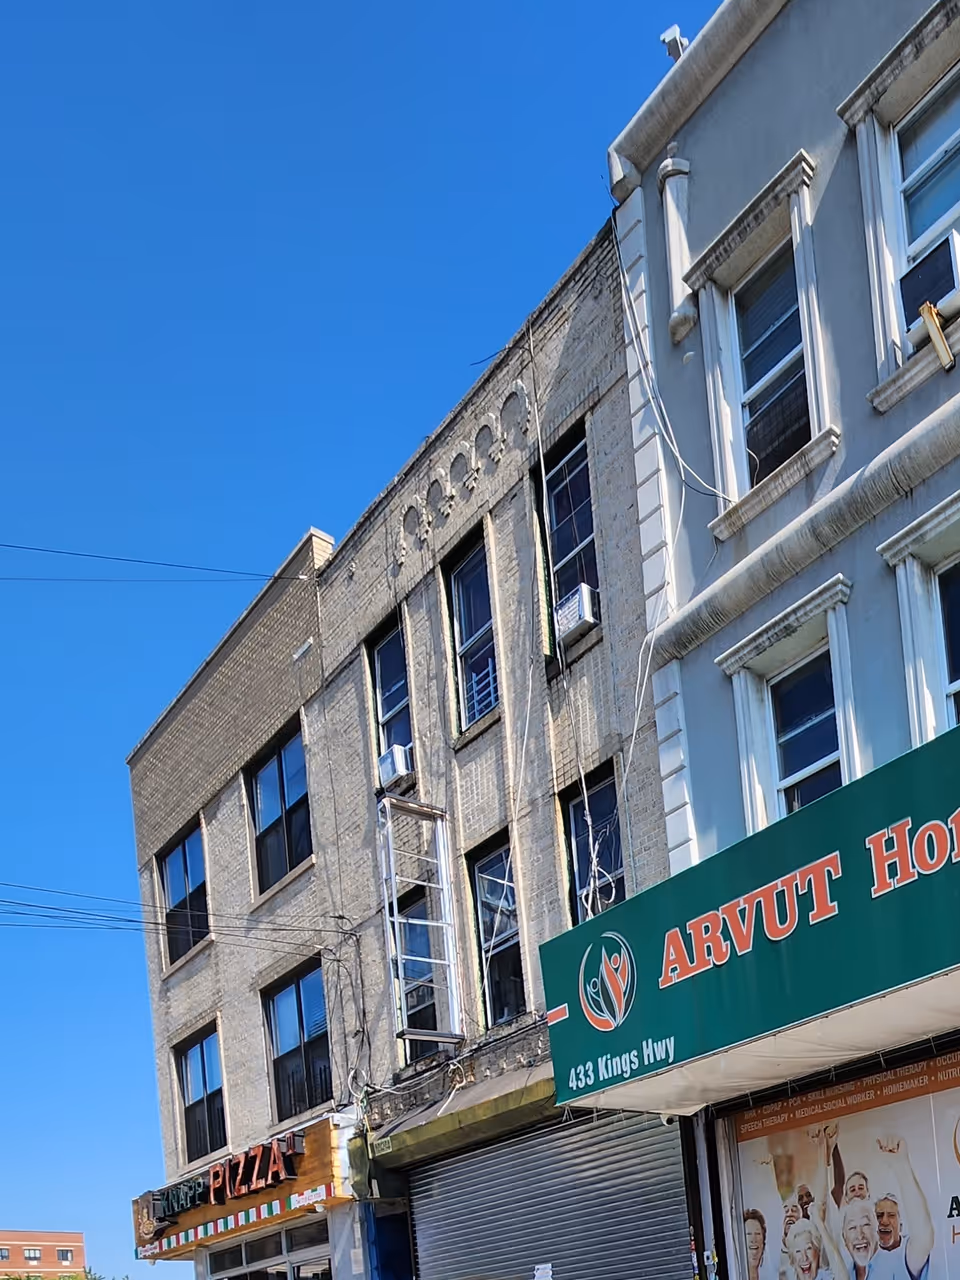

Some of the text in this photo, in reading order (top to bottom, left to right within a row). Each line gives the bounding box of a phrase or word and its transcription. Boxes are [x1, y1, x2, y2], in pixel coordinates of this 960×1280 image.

[659, 850, 842, 989] ARVUT
[568, 1035, 675, 1091] 433 Kings Hwy
[789, 1098, 801, 1108] PCA
[863, 1069, 895, 1087] PHYSICAL
[896, 1060, 927, 1079] THERAPY
[740, 1121, 762, 1134] SPEECH
[762, 1113, 789, 1128] THERAPY
[795, 1104, 823, 1119] MEDICAL
[823, 1098, 846, 1112] SOCIAL
[846, 1089, 875, 1105] WORKER
[882, 1074, 929, 1096] HOMEMAKER
[160, 1176, 205, 1217] KNAPP
[209, 1138, 286, 1205] PIZZA
